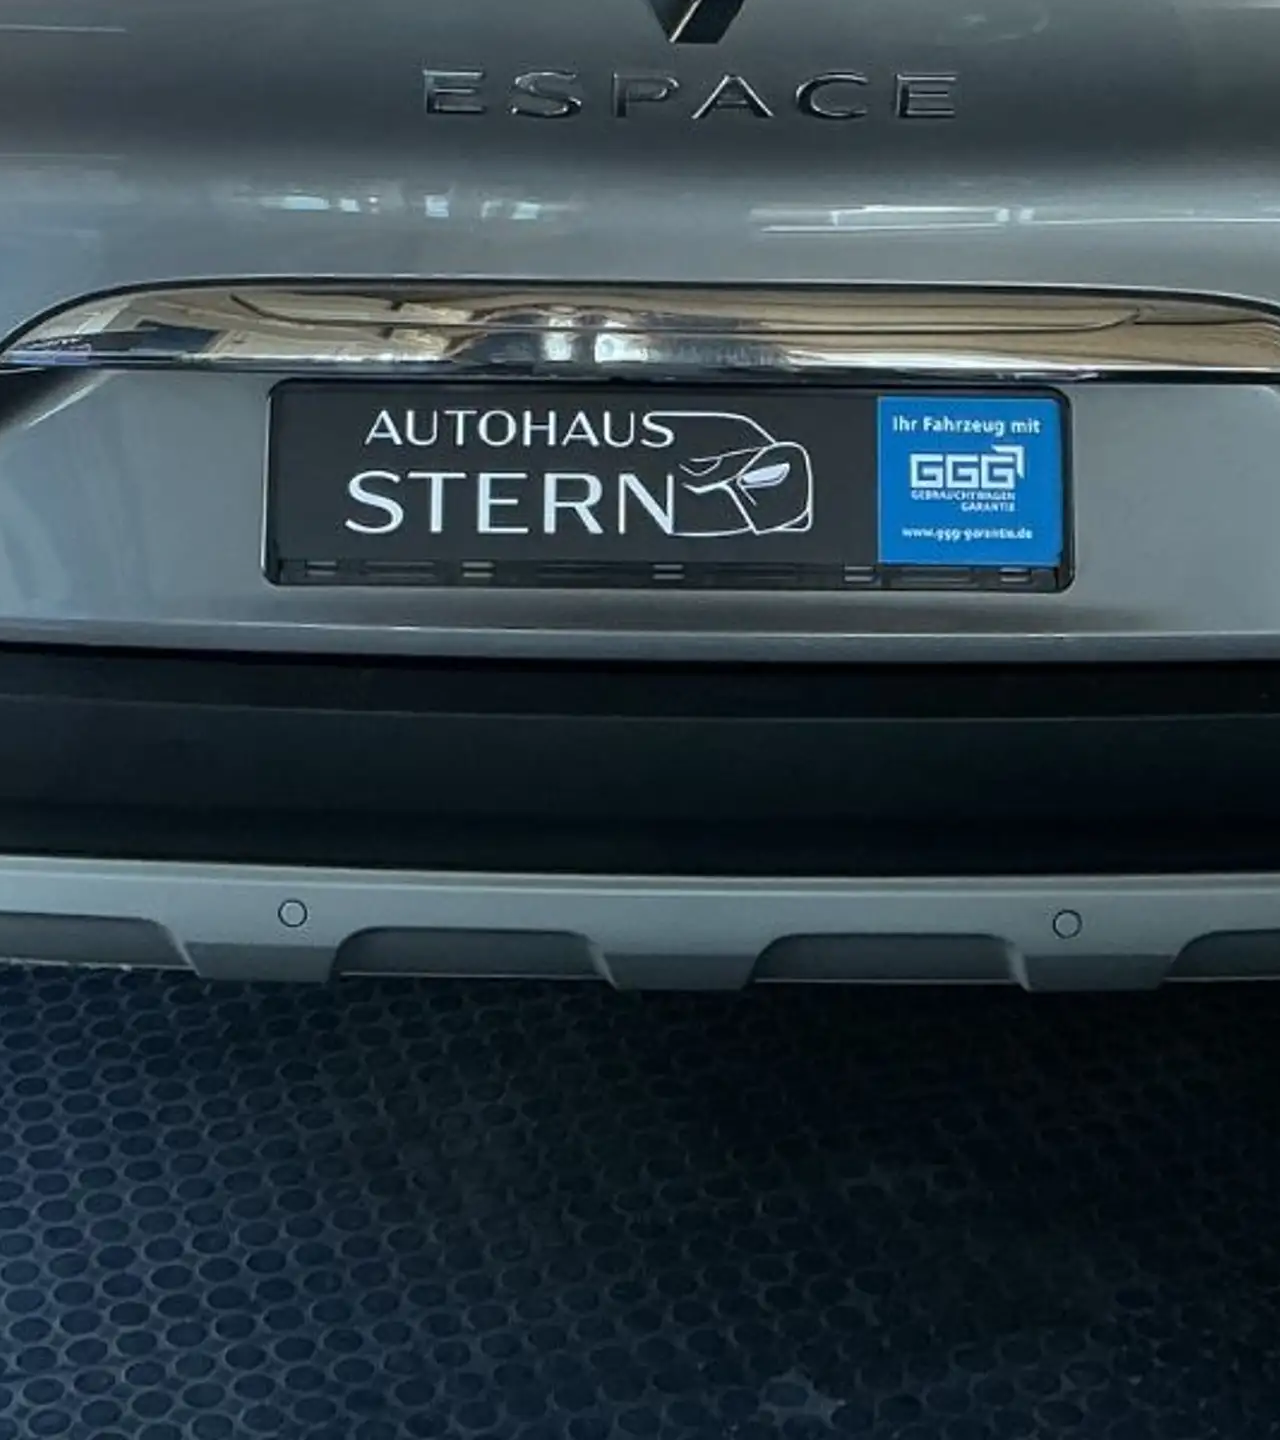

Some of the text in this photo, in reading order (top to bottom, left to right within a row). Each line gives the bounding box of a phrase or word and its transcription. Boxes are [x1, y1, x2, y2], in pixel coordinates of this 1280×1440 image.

[422, 70, 959, 119] ESPACE
[365, 409, 675, 449] AUTOHAUS
[893, 415, 1041, 437] Ihr Fahrzeug mit
[910, 453, 1016, 489] GGG
[345, 468, 675, 536] STERN
[961, 502, 1016, 512] GARANTIE
